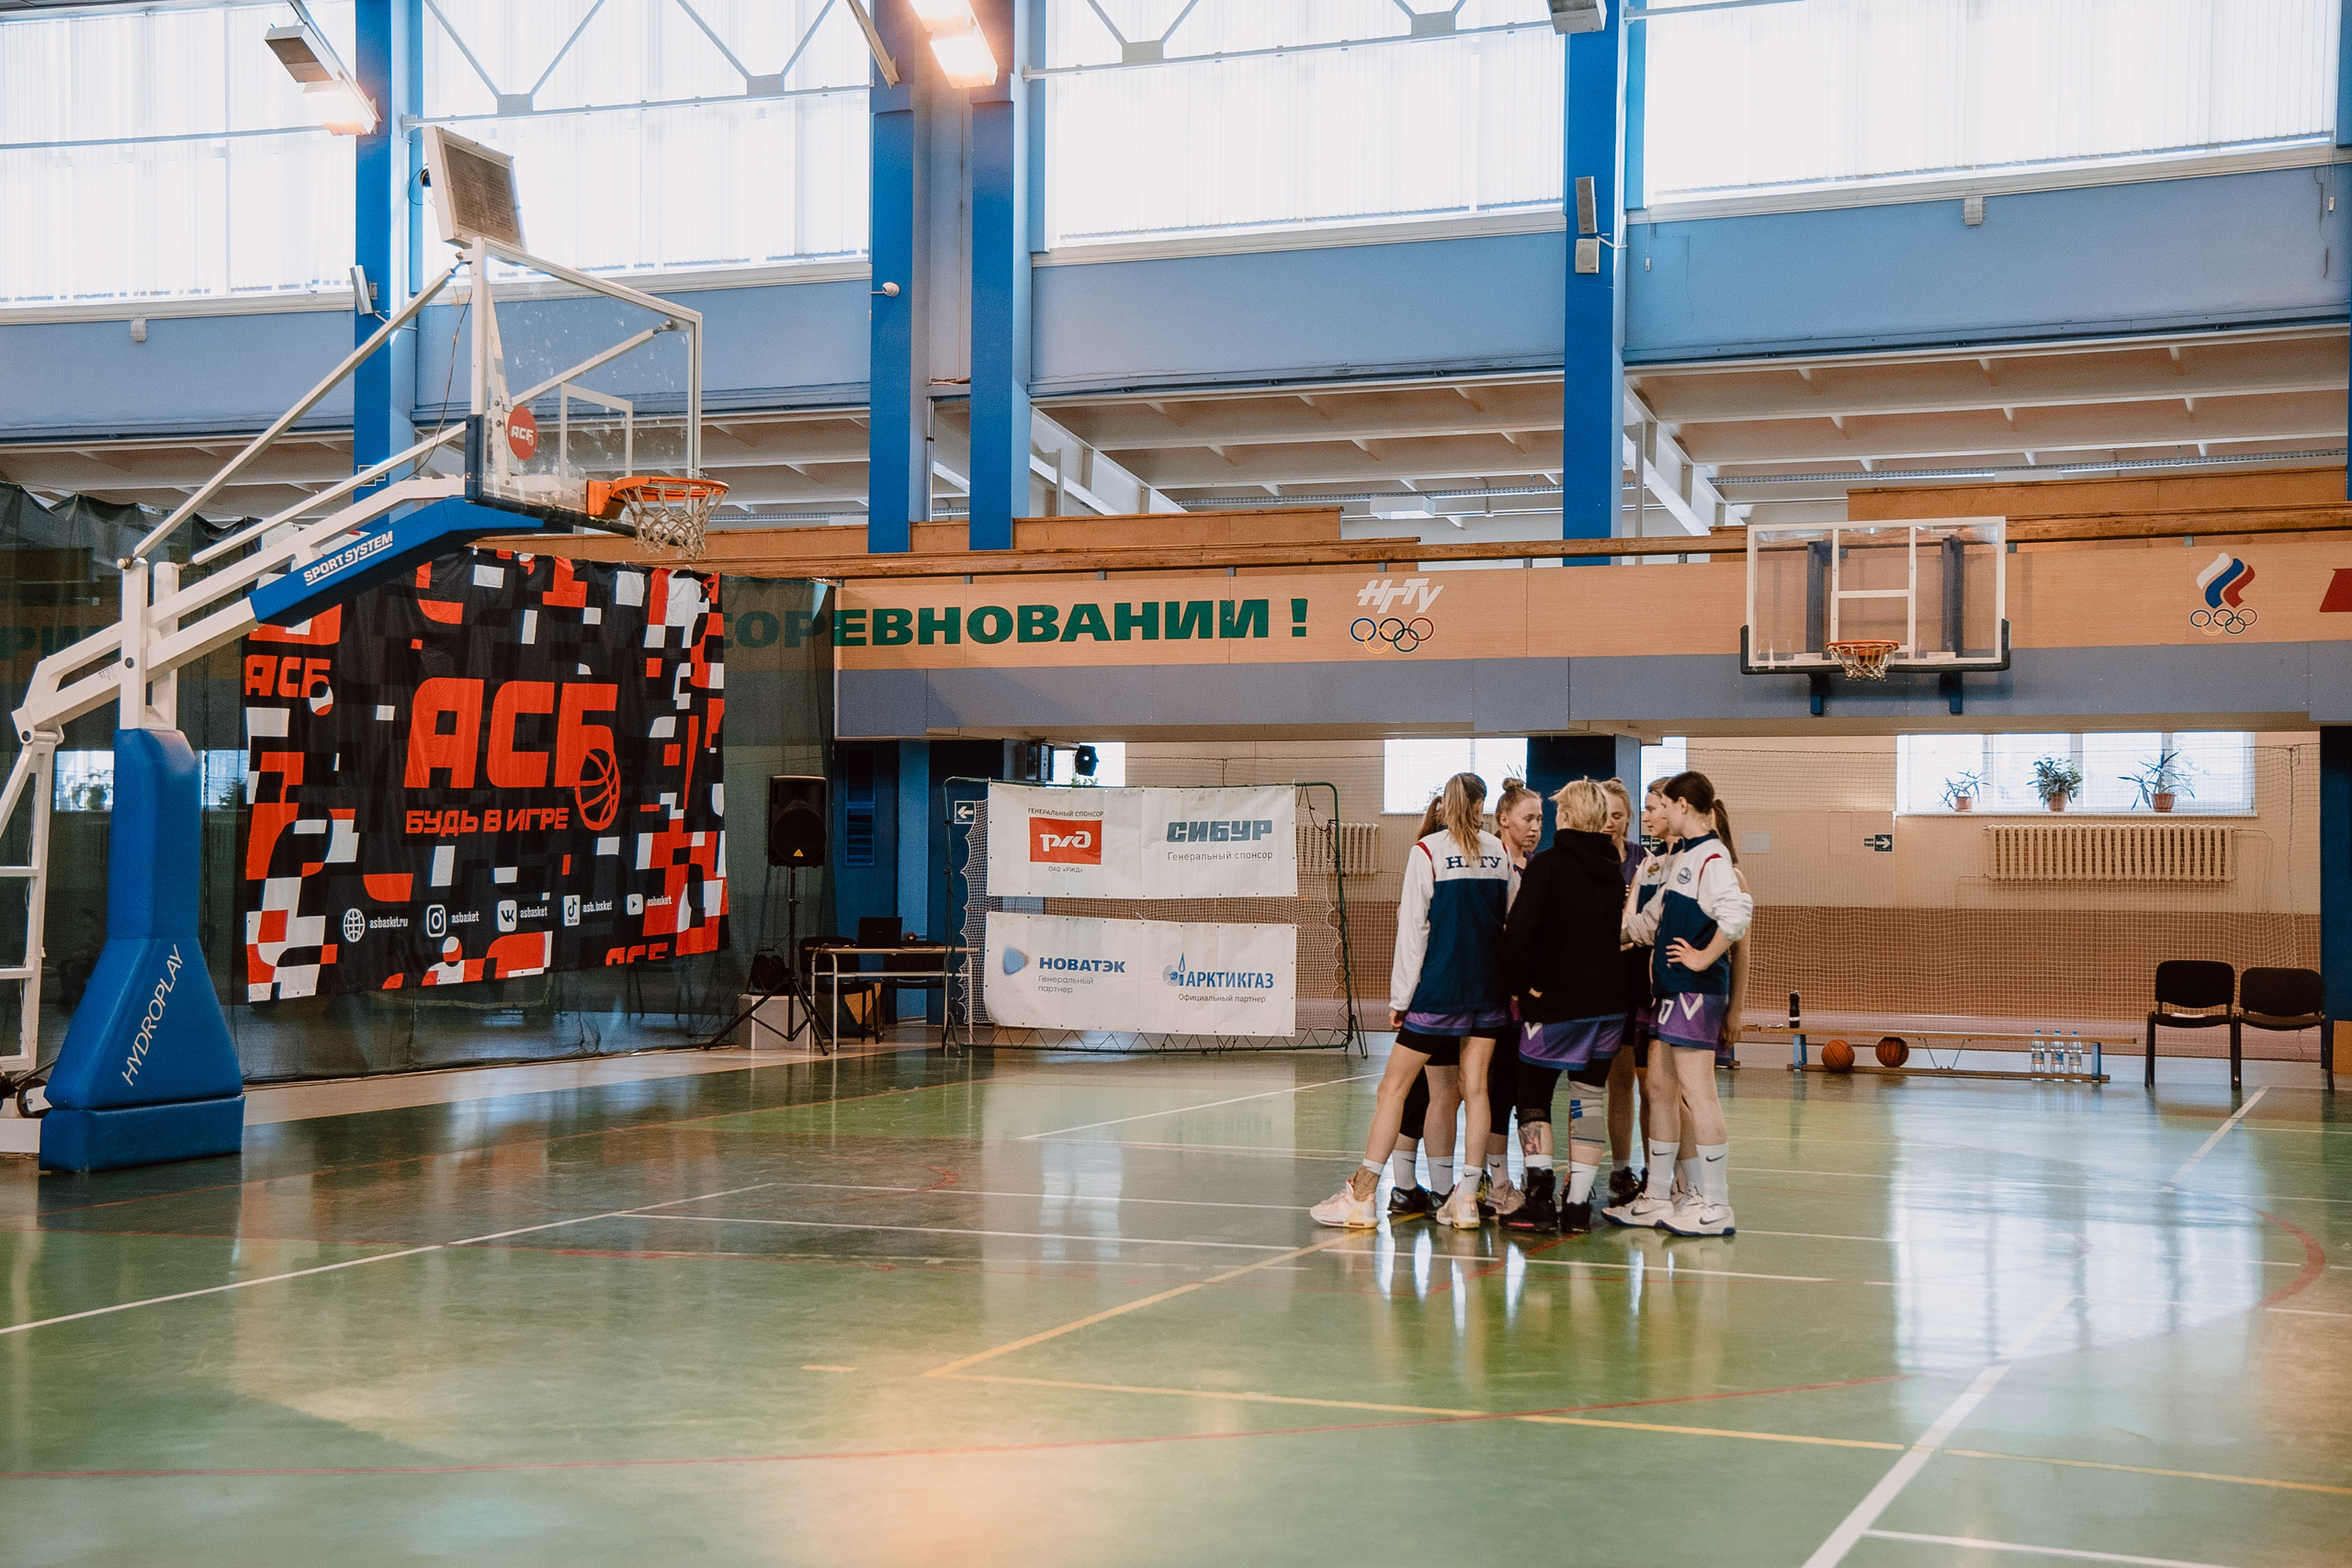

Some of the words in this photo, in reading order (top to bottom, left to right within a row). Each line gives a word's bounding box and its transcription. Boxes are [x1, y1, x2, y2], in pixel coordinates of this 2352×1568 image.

[303, 554, 345, 582] SPORT
[345, 530, 393, 563] SYSTEM
[1356, 578, 1444, 614] НГТУ
[245, 654, 334, 700] АСБ
[404, 677, 620, 816] АСБ
[1027, 807, 1074, 818] ГЕНЕРАЛЬНЫЙ
[405, 809, 479, 838] БУДЬ
[483, 809, 503, 832] В
[506, 807, 570, 832] ИГРЕ
[1166, 819, 1272, 842] СИБУР
[1167, 851, 1232, 863] Генеральный
[1234, 852, 1273, 862] спонсор
[520, 906, 548, 919] asbasket
[1039, 957, 1126, 974] НОВАТЭК
[1038, 975, 1094, 985] Генеральный
[1185, 971, 1274, 989] АРКТИКГАЗ
[1037, 985, 1073, 994] партнер
[1178, 993, 1233, 1003] Официальный
[1235, 995, 1267, 1004] партнер
[121, 943, 184, 1087] HYDROPLAY
